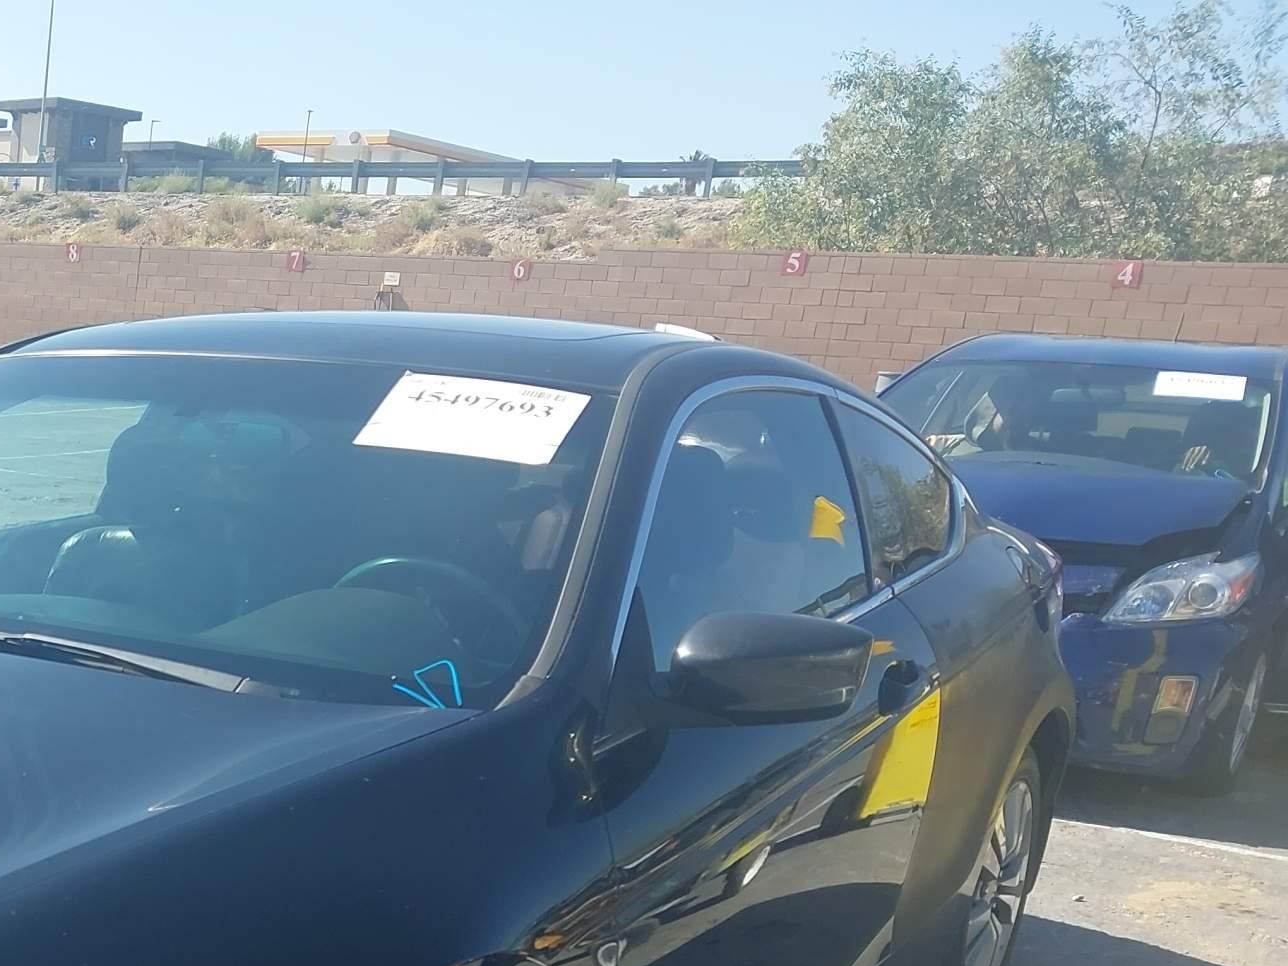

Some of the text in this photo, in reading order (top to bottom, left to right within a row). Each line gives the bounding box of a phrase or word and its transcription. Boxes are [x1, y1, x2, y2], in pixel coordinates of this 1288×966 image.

[68, 244, 77, 262] 8
[290, 252, 300, 270] 7
[786, 252, 801, 273] 5
[513, 259, 526, 279] 6
[1117, 262, 1134, 285] 4
[407, 389, 554, 418] 45497693
